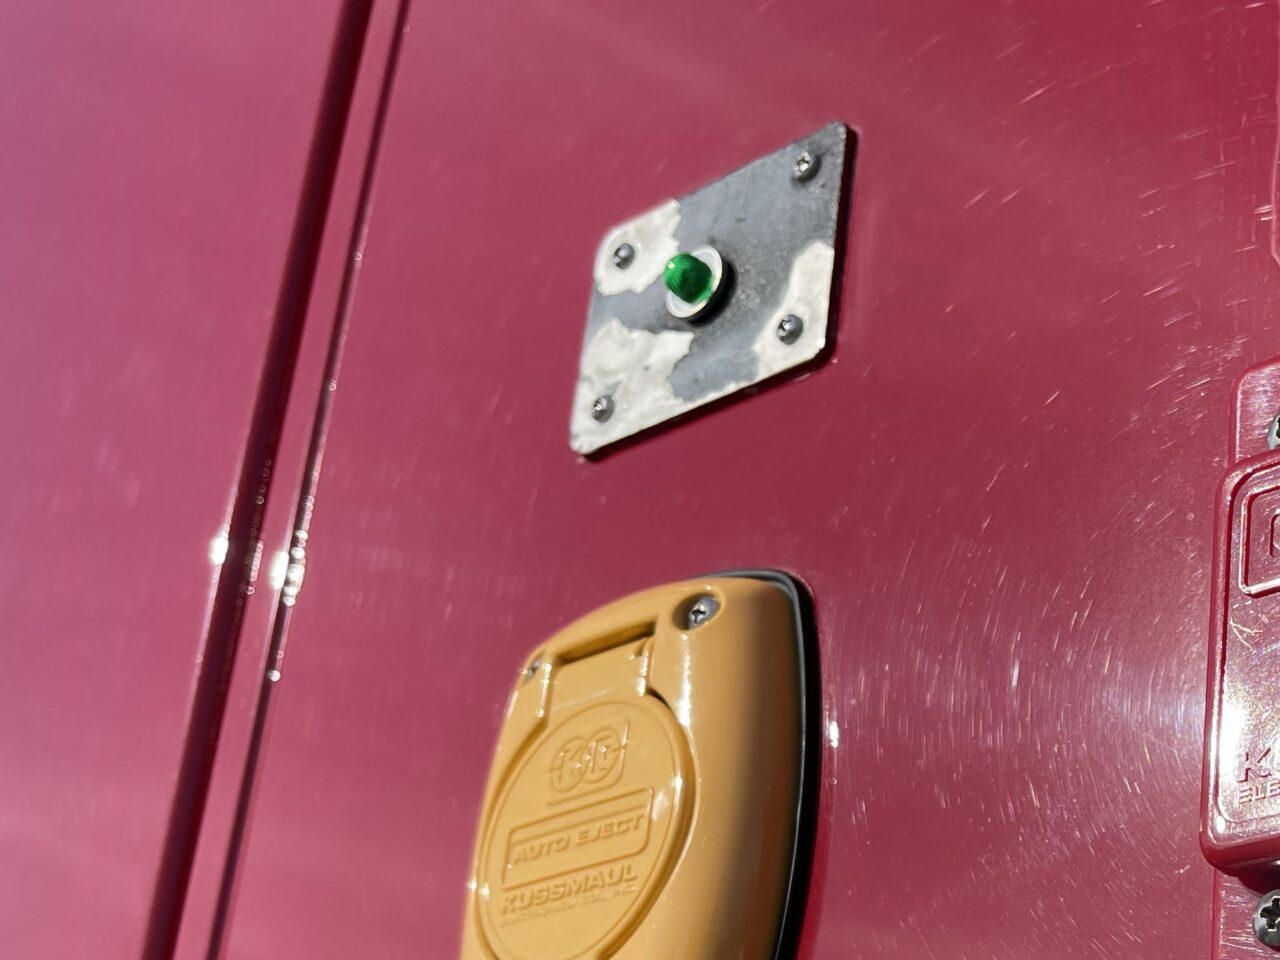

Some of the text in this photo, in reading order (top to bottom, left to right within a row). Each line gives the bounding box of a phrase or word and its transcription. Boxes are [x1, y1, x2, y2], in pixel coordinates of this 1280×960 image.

[513, 812, 645, 866] AUTO EJECT
[501, 862, 640, 917] KUSSMAUL
